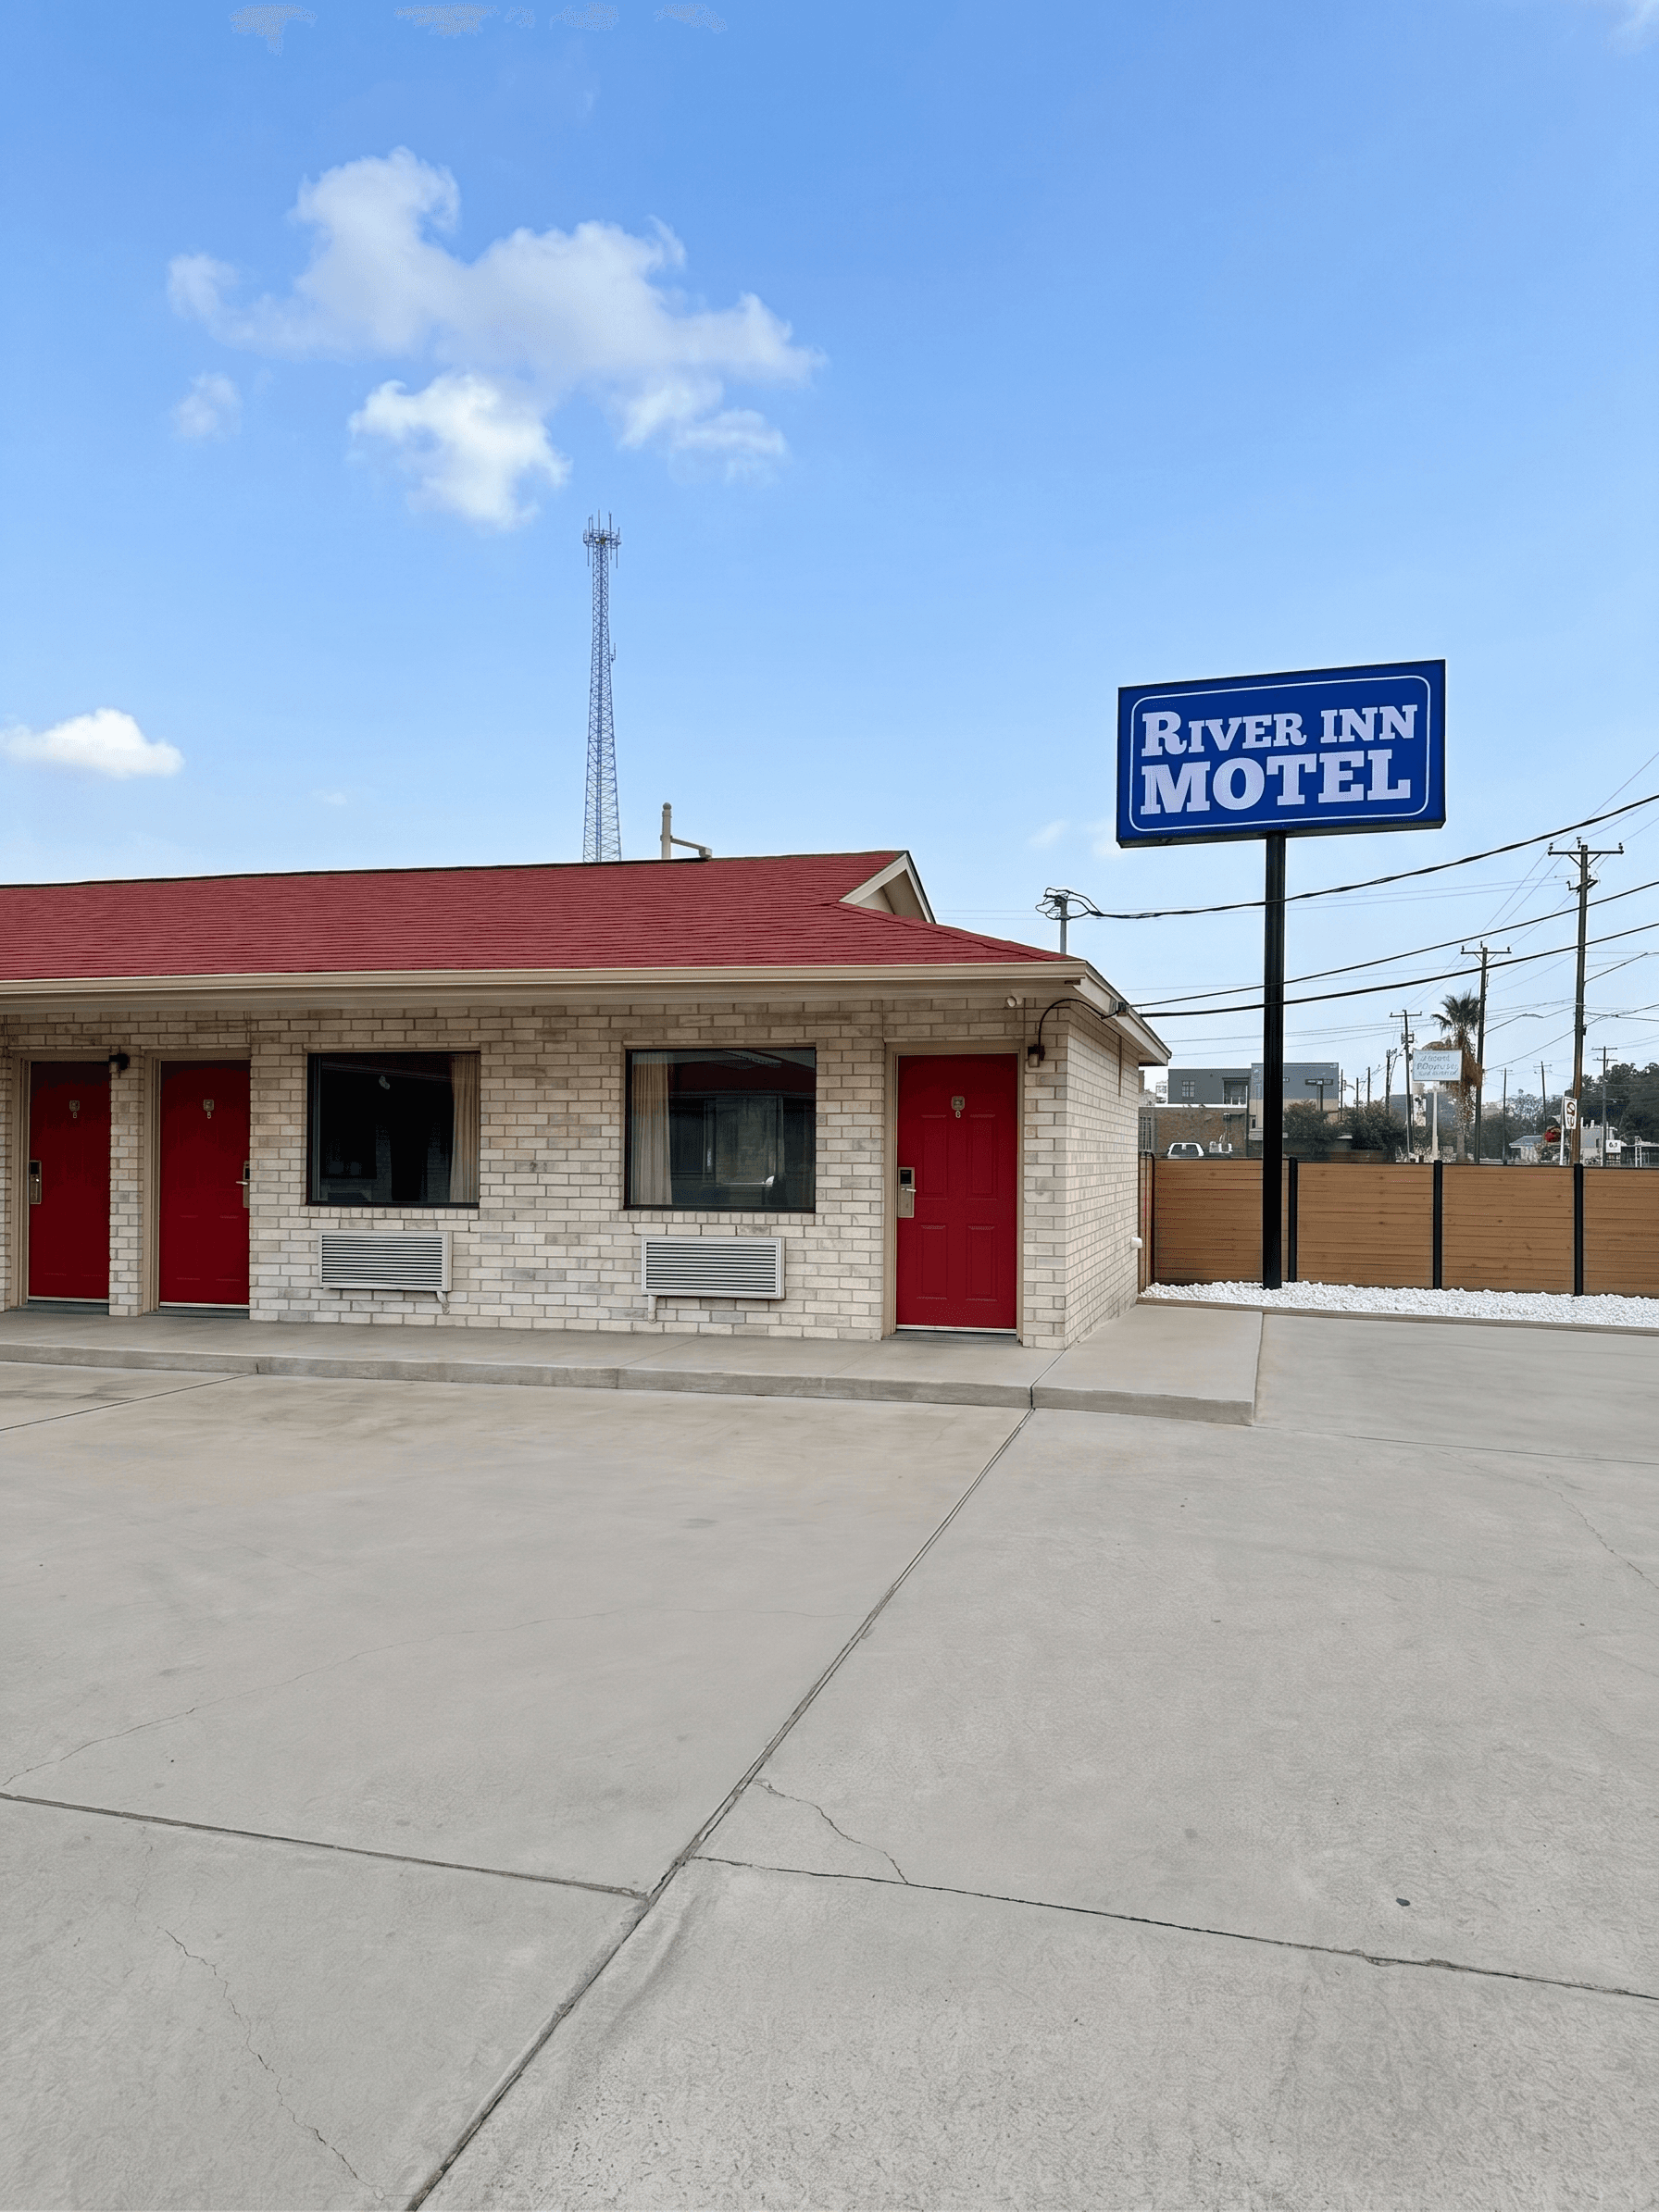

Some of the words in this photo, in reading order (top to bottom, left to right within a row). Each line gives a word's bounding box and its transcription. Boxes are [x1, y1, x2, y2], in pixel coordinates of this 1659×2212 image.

[1141, 711, 1307, 757] RIVER
[1320, 704, 1418, 744] INN
[1140, 749, 1411, 815] MOTEL
